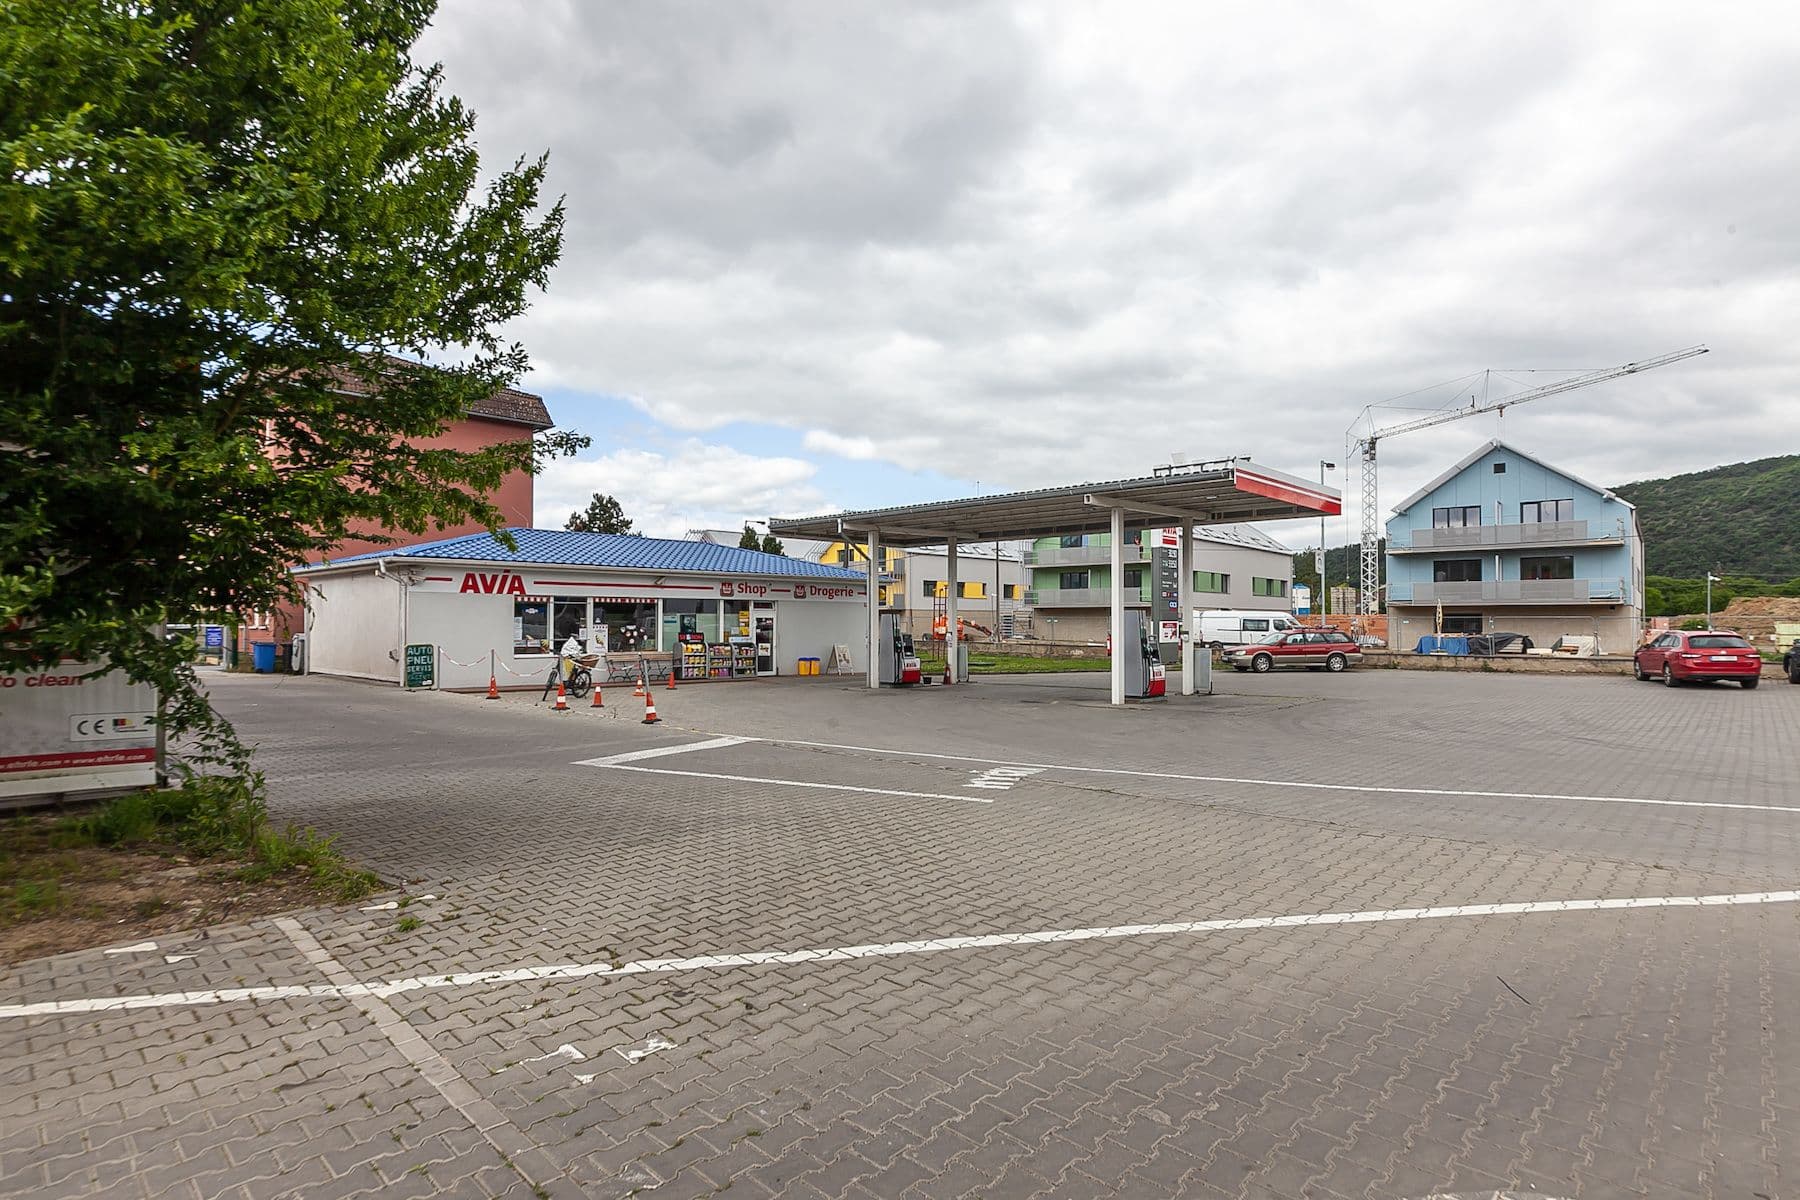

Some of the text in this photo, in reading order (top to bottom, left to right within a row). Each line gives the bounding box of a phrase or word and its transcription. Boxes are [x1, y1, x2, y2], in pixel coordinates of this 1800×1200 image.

[737, 582, 767, 597] Shop
[809, 585, 854, 599] Drogerie
[407, 647, 433, 655] AUTO
[407, 656, 433, 665] PNEU
[24, 673, 84, 687] clean
